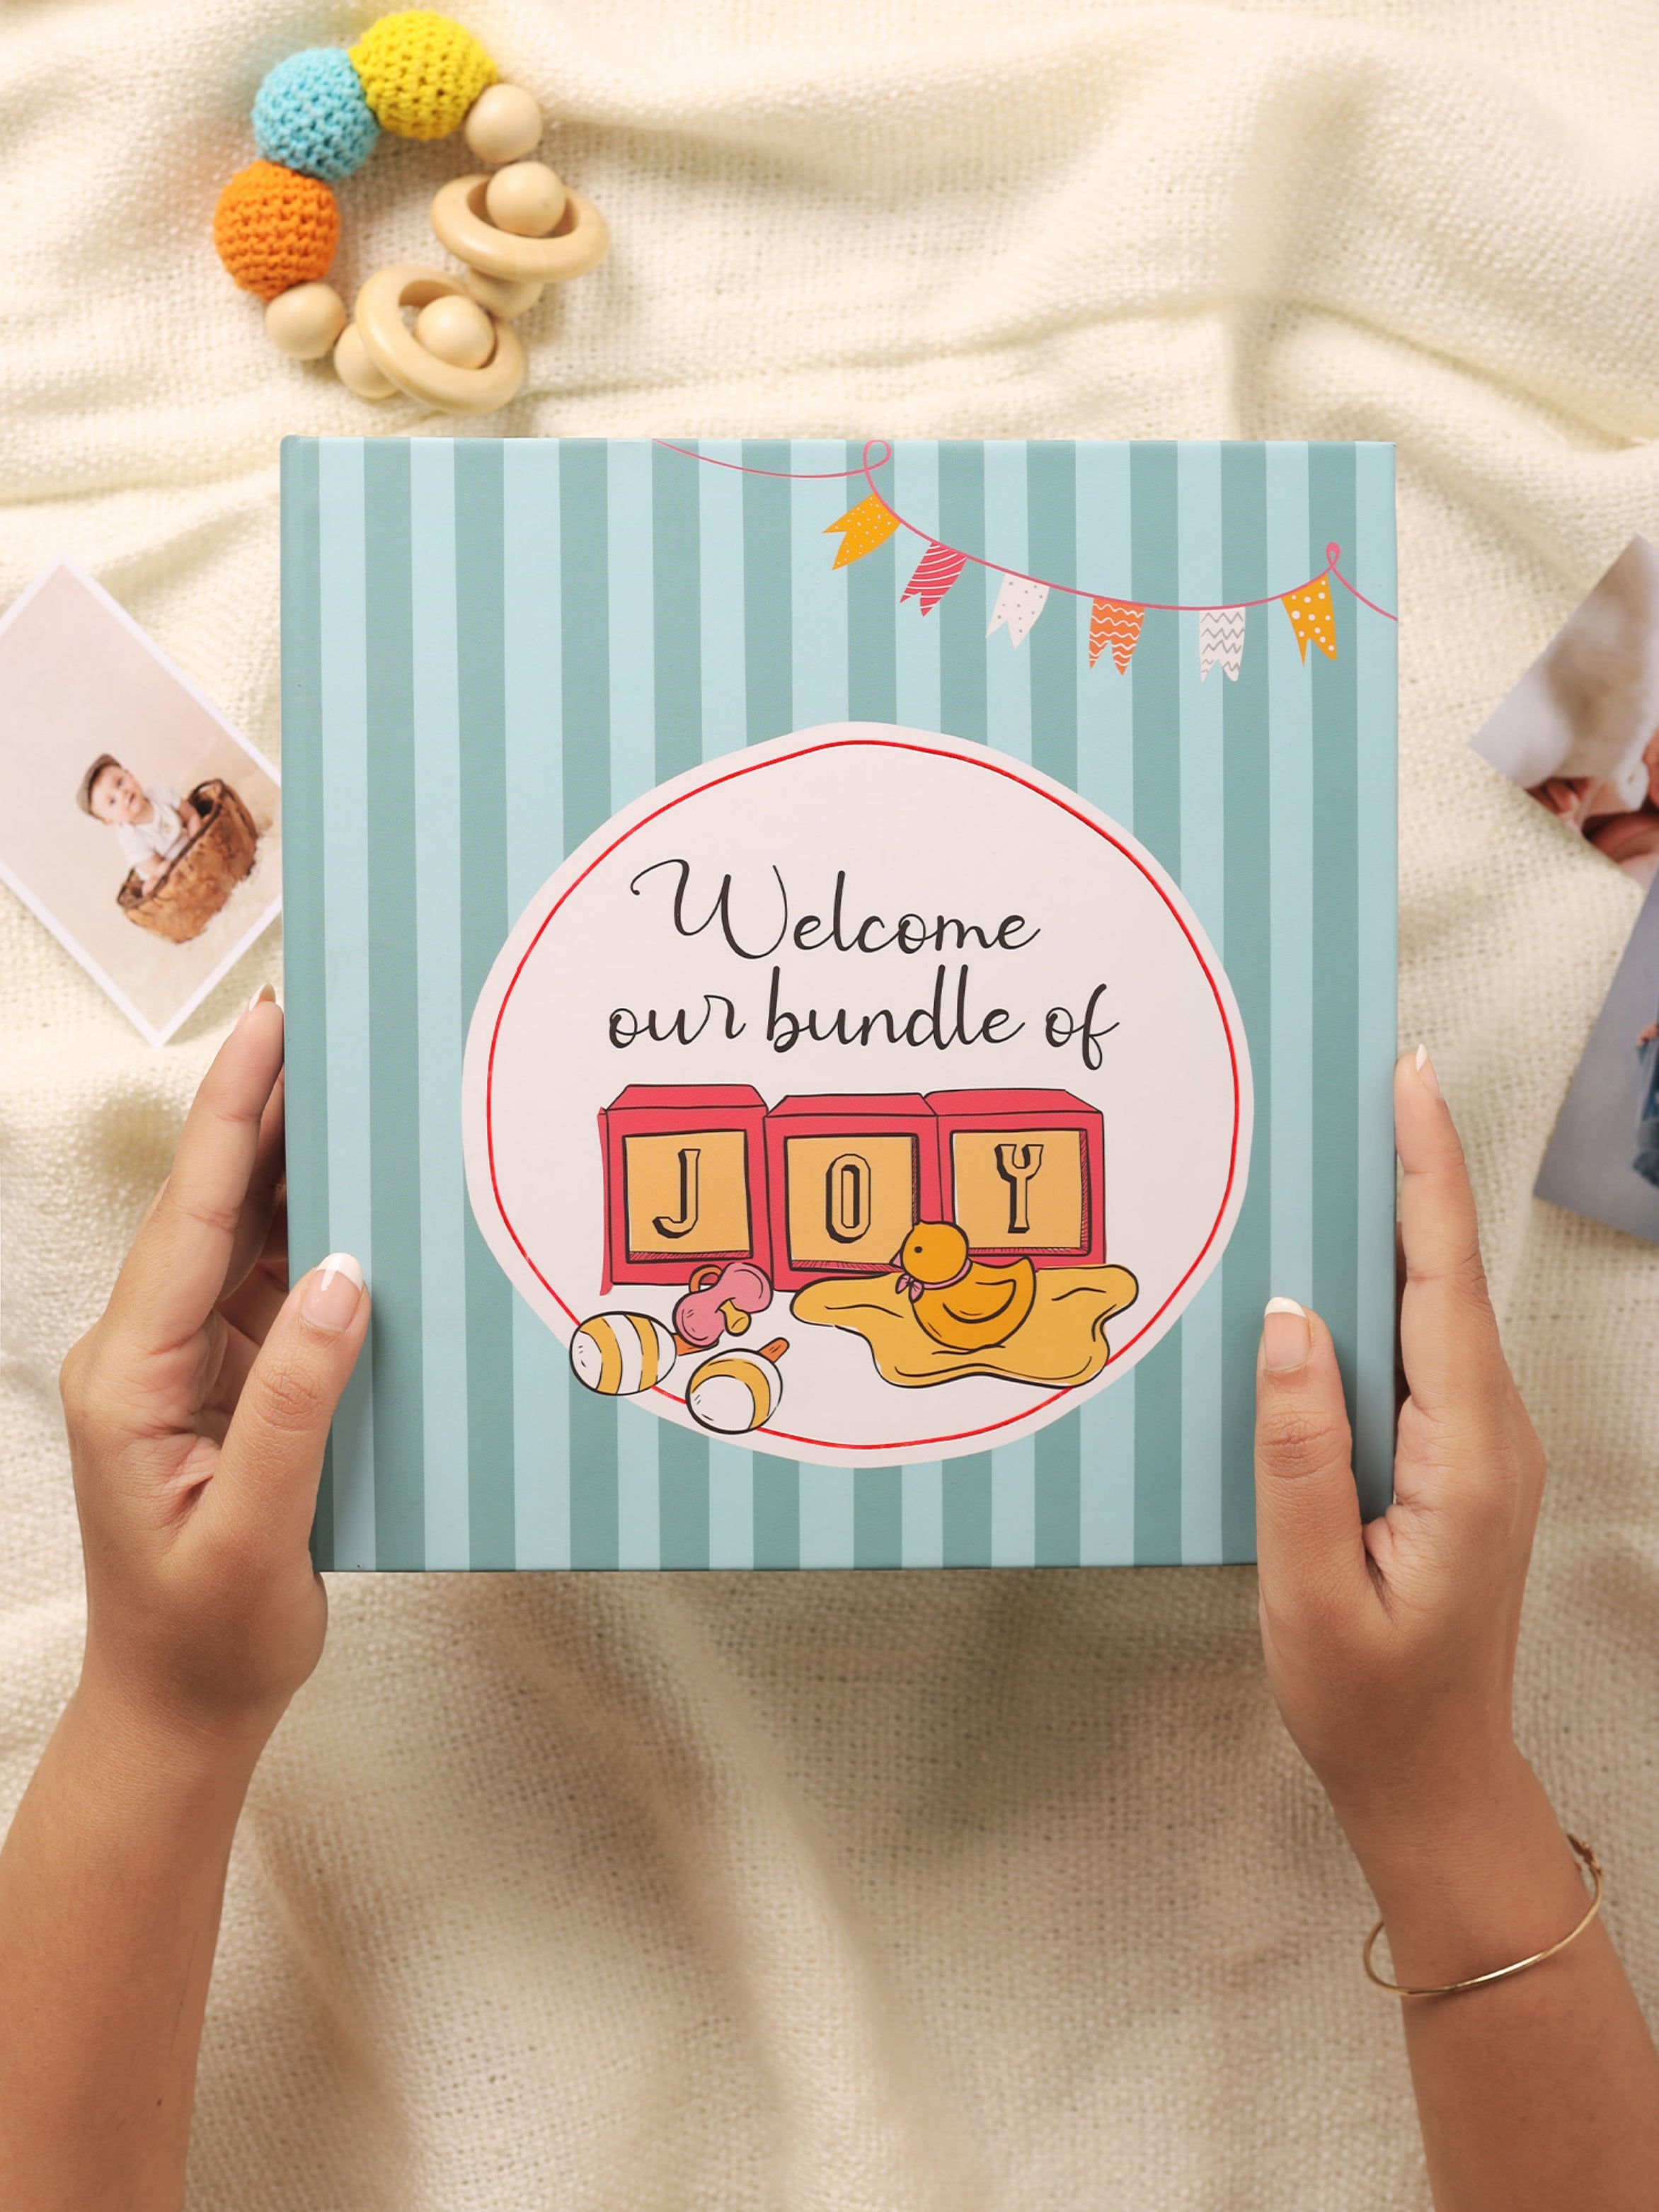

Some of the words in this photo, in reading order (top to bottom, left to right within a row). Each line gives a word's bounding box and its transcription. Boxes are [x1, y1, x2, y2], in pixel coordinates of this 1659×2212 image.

[630, 859, 1042, 960] Welcome
[608, 994, 747, 1049] our
[766, 964, 1026, 1053] bundle
[1045, 982, 1120, 1071] of
[652, 1142, 1045, 1244] JOY
